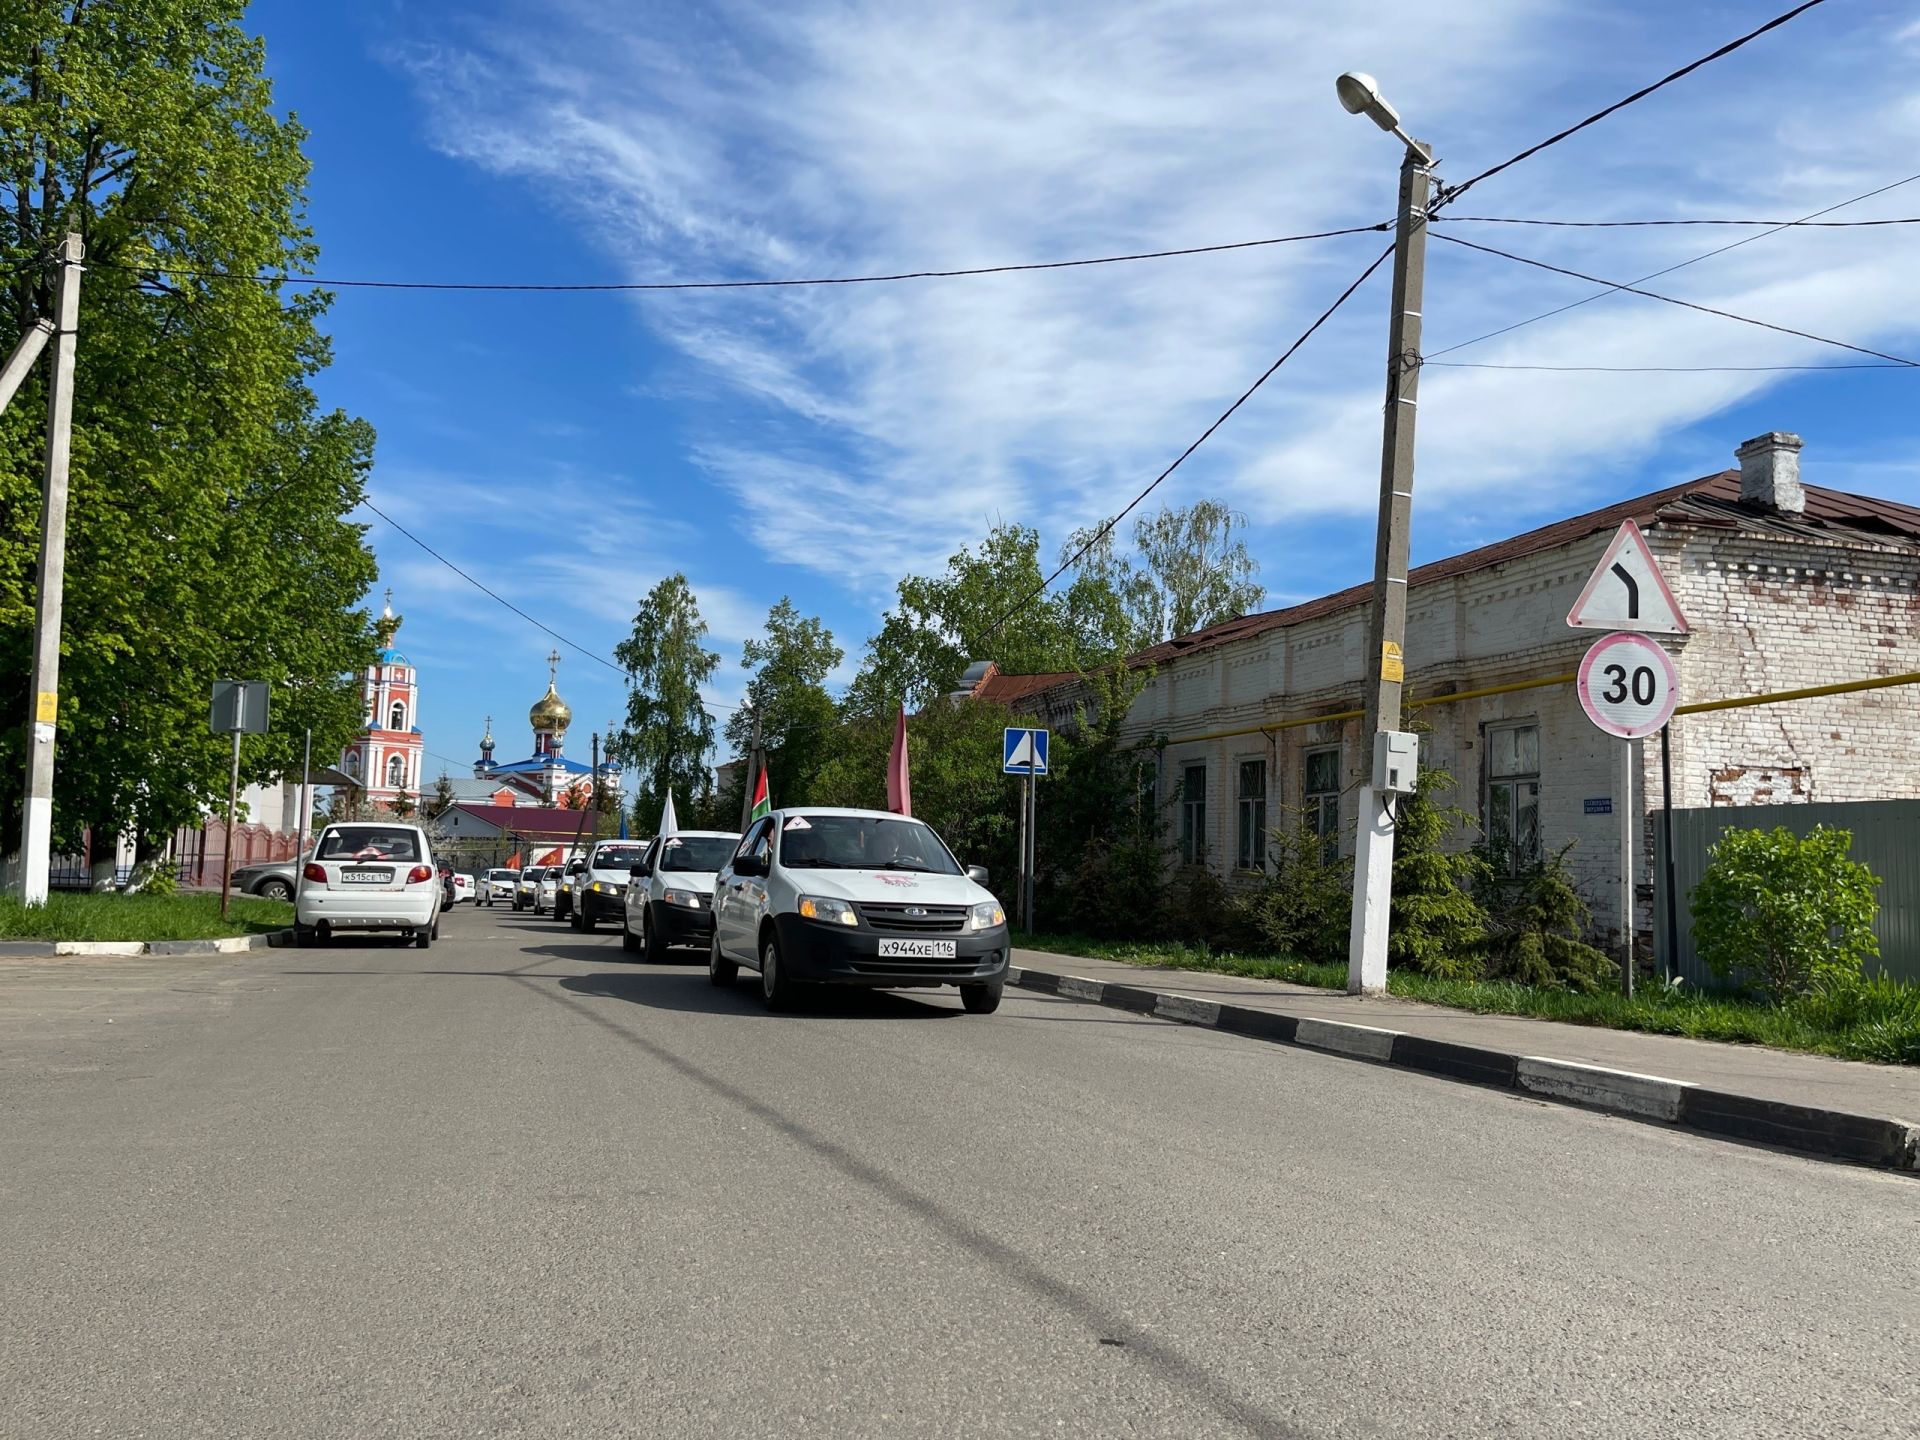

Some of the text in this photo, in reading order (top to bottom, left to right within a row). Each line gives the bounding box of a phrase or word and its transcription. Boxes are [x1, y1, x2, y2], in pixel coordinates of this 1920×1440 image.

[1602, 664, 1656, 706] 30
[378, 873, 390, 881] 116
[883, 941, 953, 956] Х944ХЕ 116
